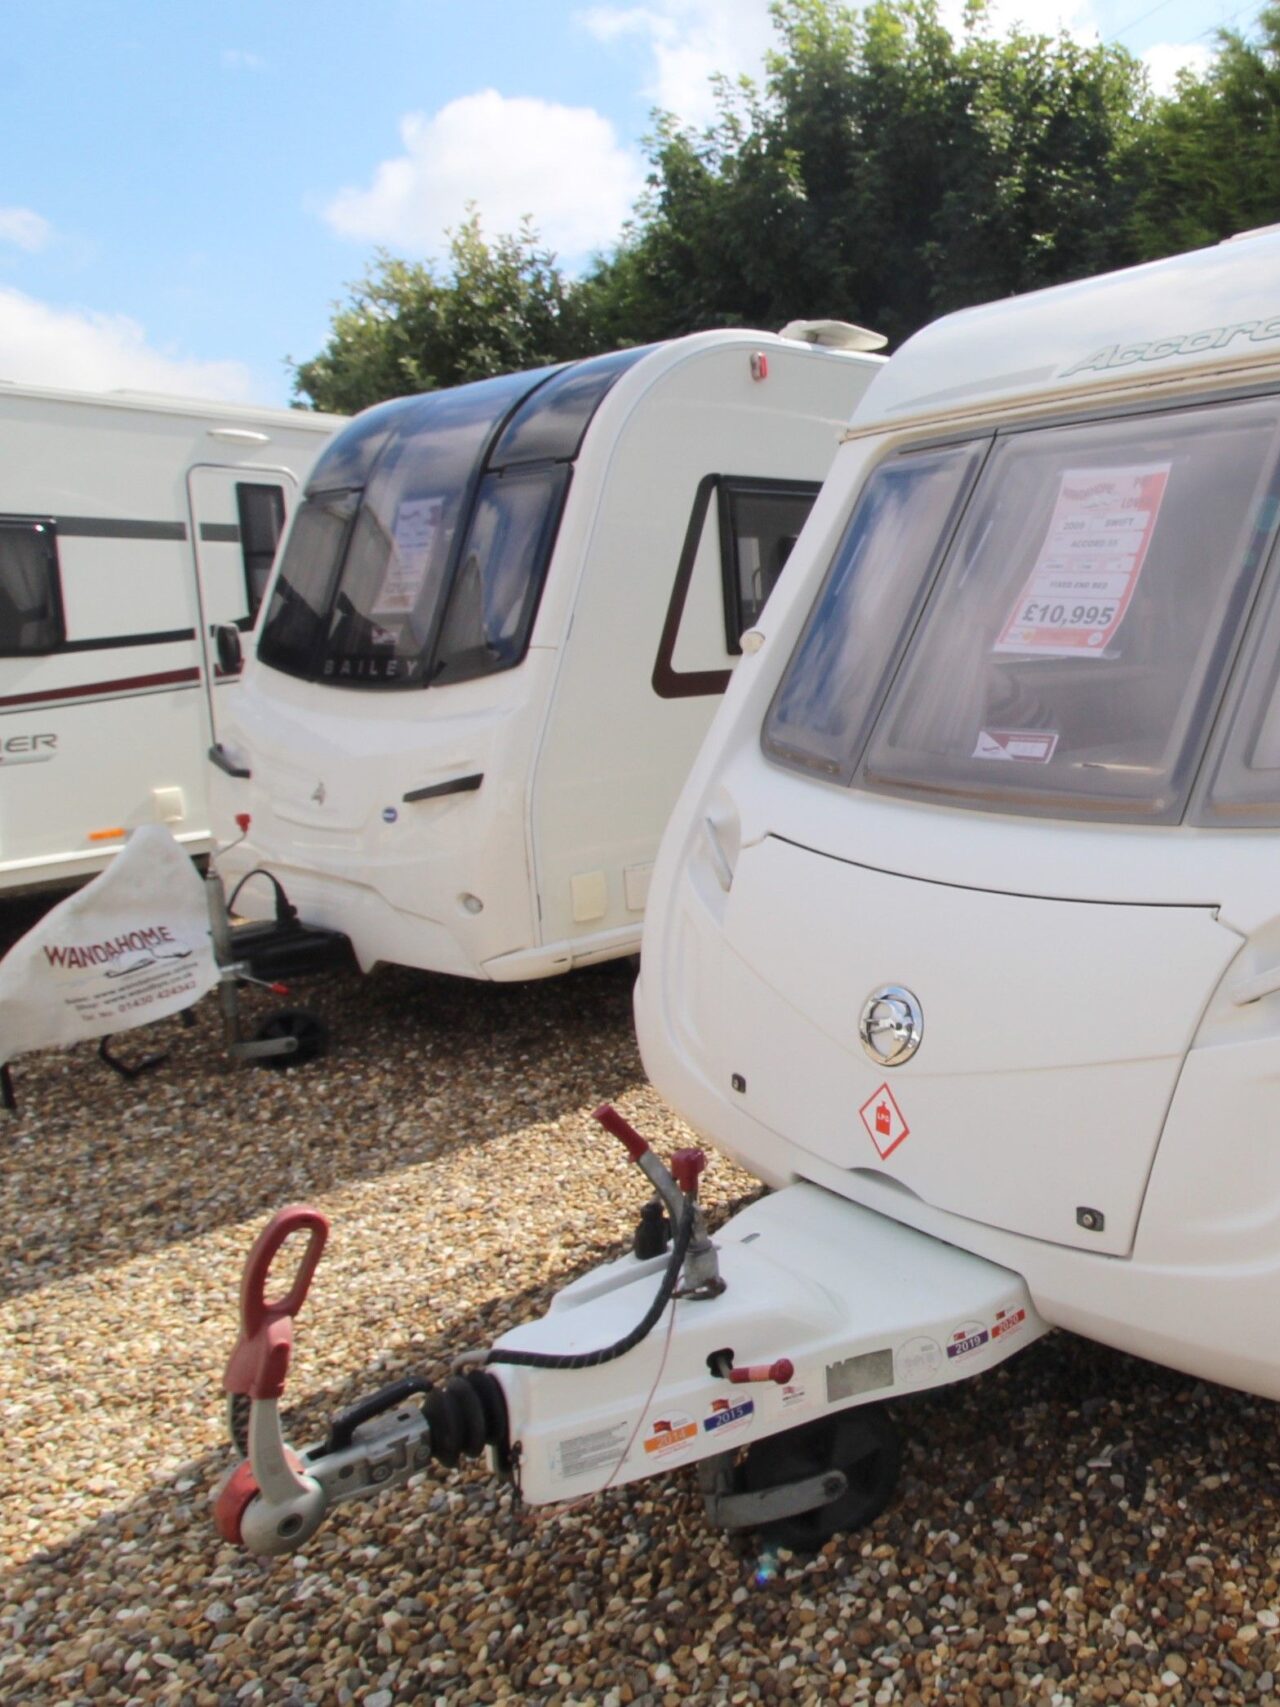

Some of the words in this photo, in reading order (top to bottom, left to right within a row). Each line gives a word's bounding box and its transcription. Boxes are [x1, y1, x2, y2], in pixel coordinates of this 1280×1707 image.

[1022, 604, 1114, 626] £10,995
[323, 659, 418, 676] BAILEY
[0, 733, 58, 752] ER
[43, 926, 175, 969] WANDAHOME
[955, 1334, 982, 1354] 2019
[716, 1406, 744, 1426] 2015
